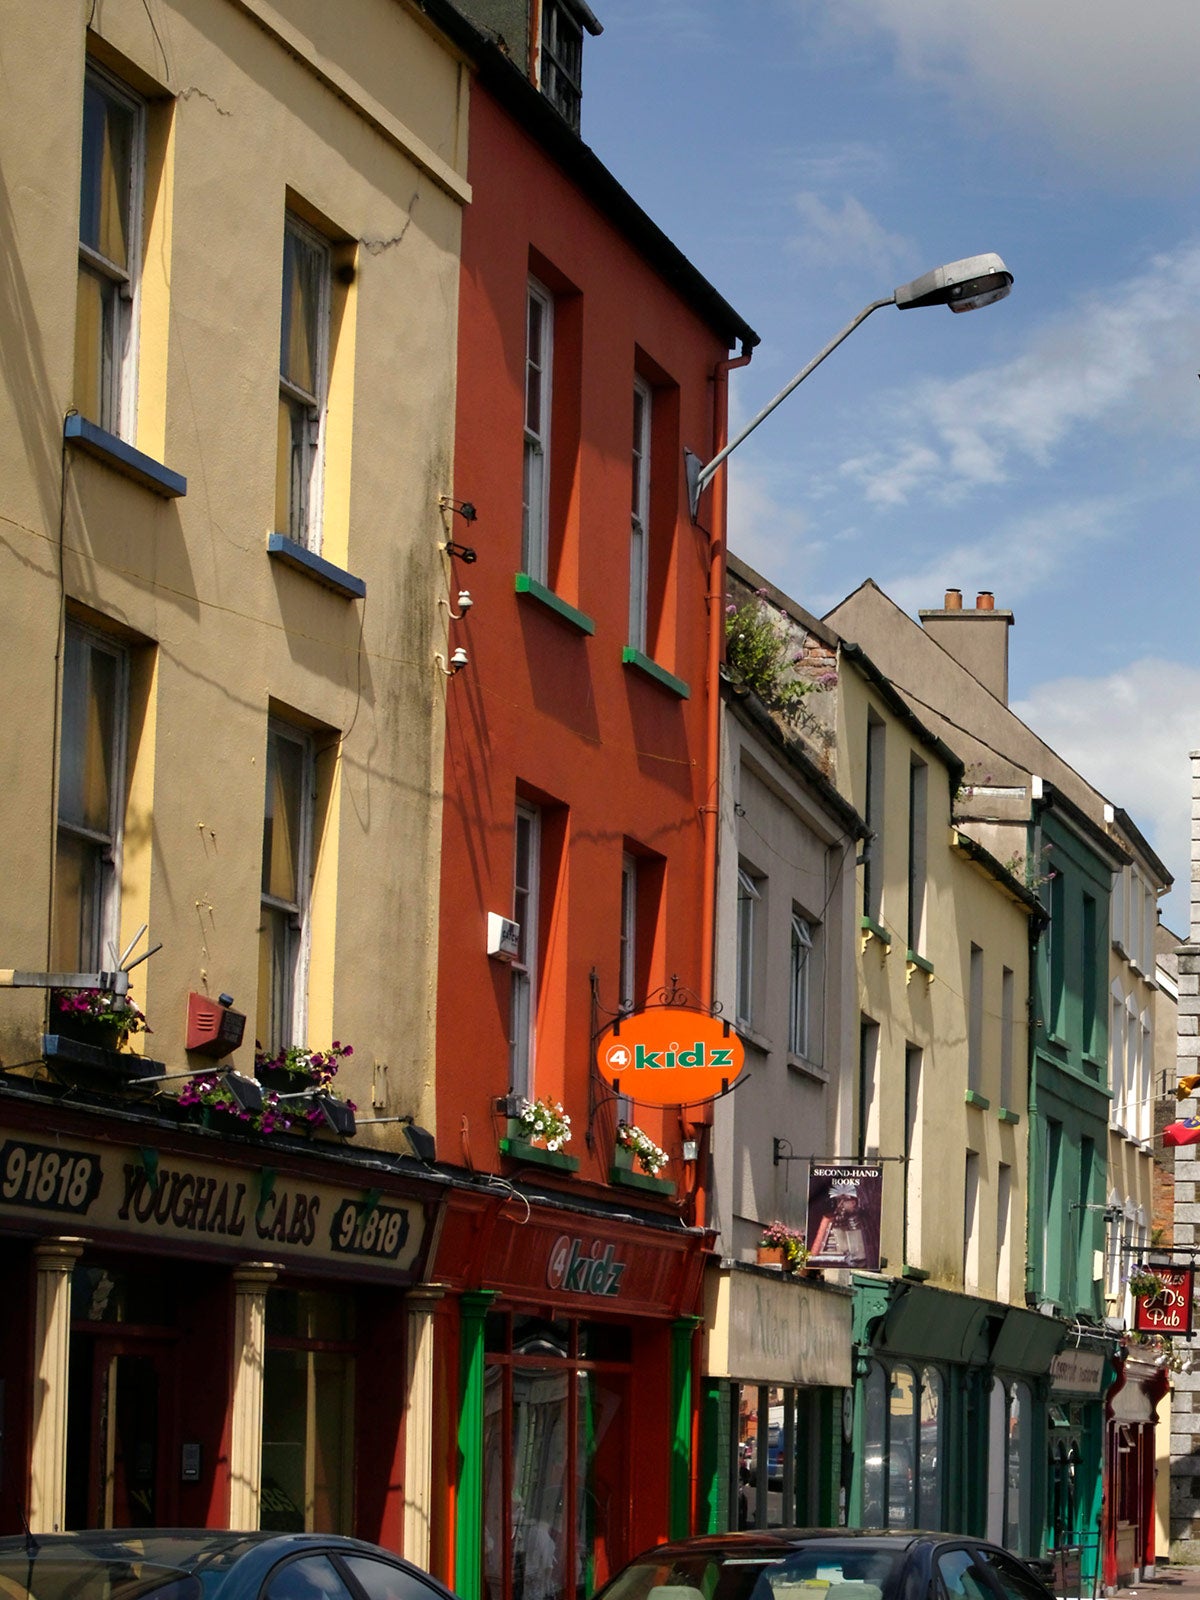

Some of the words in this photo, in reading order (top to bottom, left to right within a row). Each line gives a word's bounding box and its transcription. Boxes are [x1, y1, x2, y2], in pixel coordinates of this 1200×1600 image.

[606, 1042, 734, 1071] 4kidz
[813, 1169, 879, 1178] SECOND-HAND
[3, 1148, 92, 1207] 91818
[118, 1163, 246, 1236] YOUGHAL
[255, 1190, 320, 1247] CABS
[339, 1205, 402, 1253] 91818
[547, 1235, 627, 1297] 4kidz
[1147, 1308, 1180, 1327] Pub
